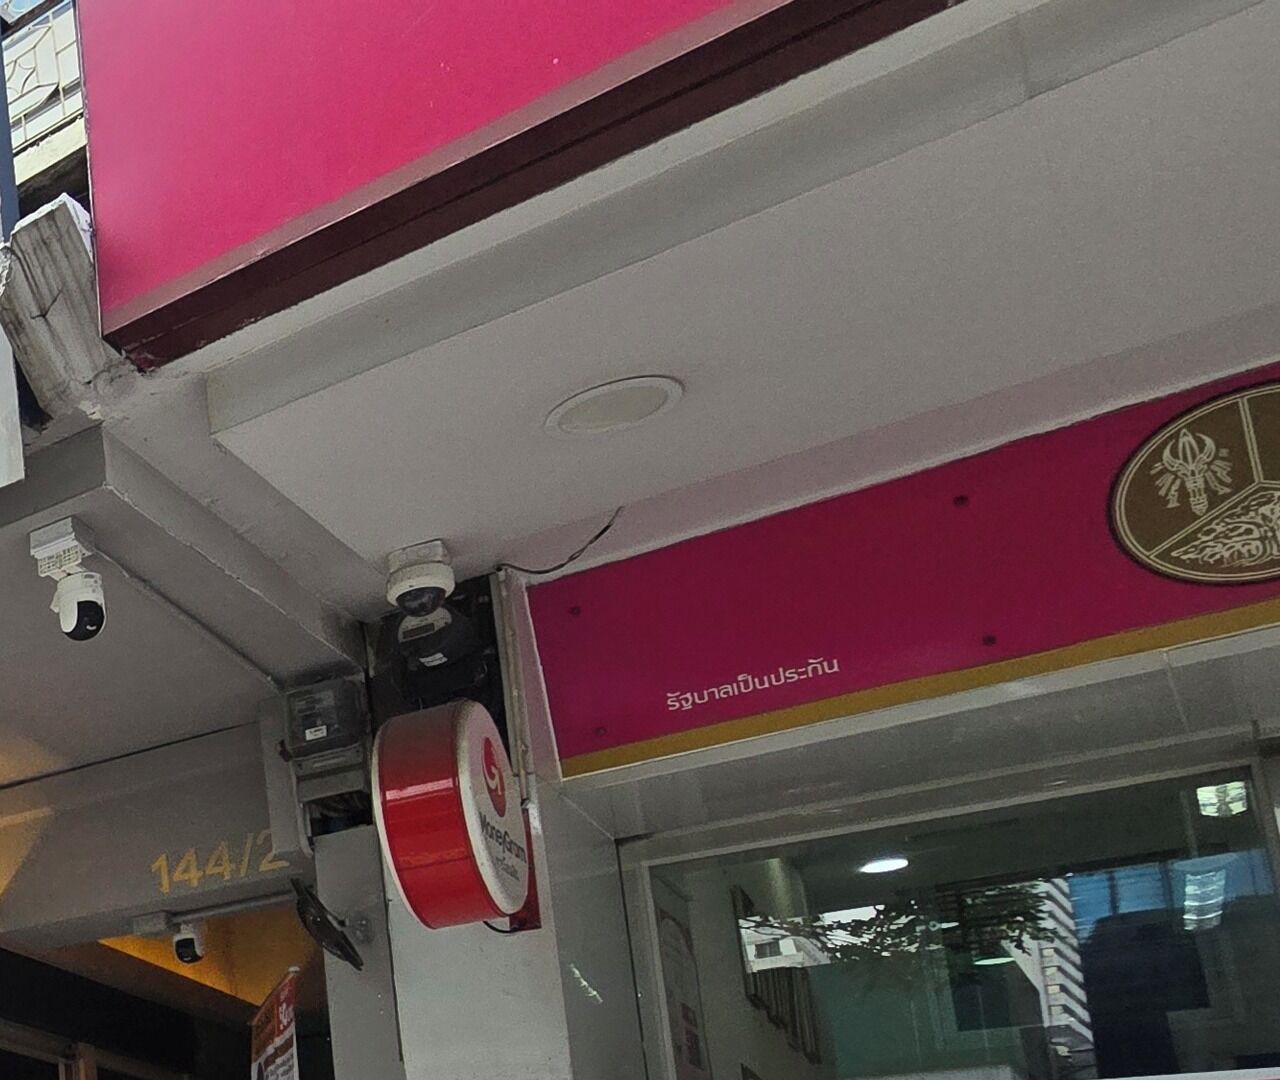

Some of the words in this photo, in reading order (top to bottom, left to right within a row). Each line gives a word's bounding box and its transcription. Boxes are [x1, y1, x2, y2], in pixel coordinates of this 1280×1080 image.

[666, 655, 840, 713] รัฐบาลเป็นประกัน
[150, 828, 290, 895] 144/2
